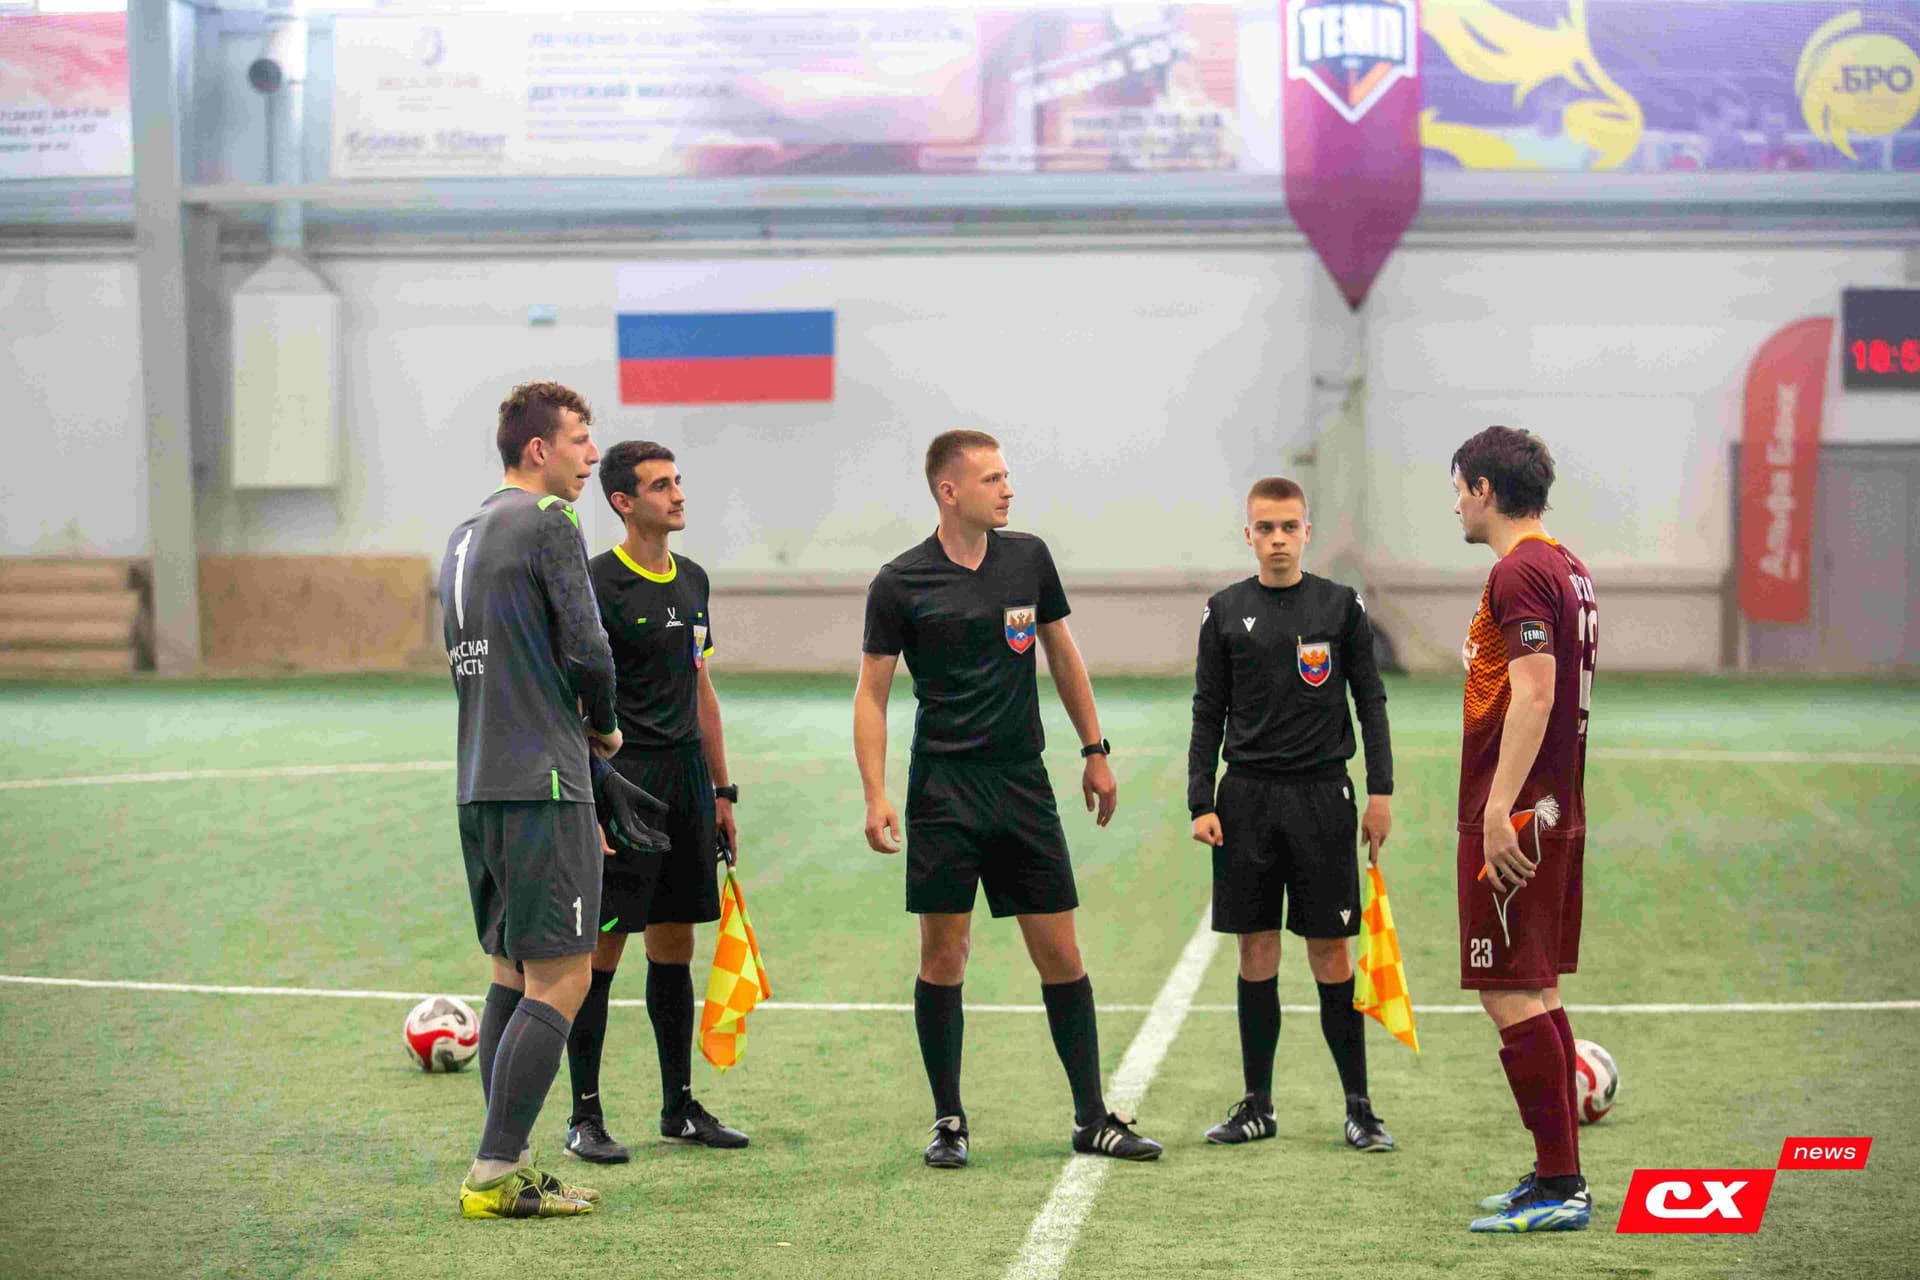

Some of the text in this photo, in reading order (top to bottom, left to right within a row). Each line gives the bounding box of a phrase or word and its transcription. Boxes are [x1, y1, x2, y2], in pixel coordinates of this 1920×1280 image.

[1300, 4, 1402, 61] ТЕМП
[454, 529, 473, 630] 1
[1523, 629, 1546, 643] ТЕМП
[572, 896, 583, 937] 1
[1470, 937, 1494, 968] 23
